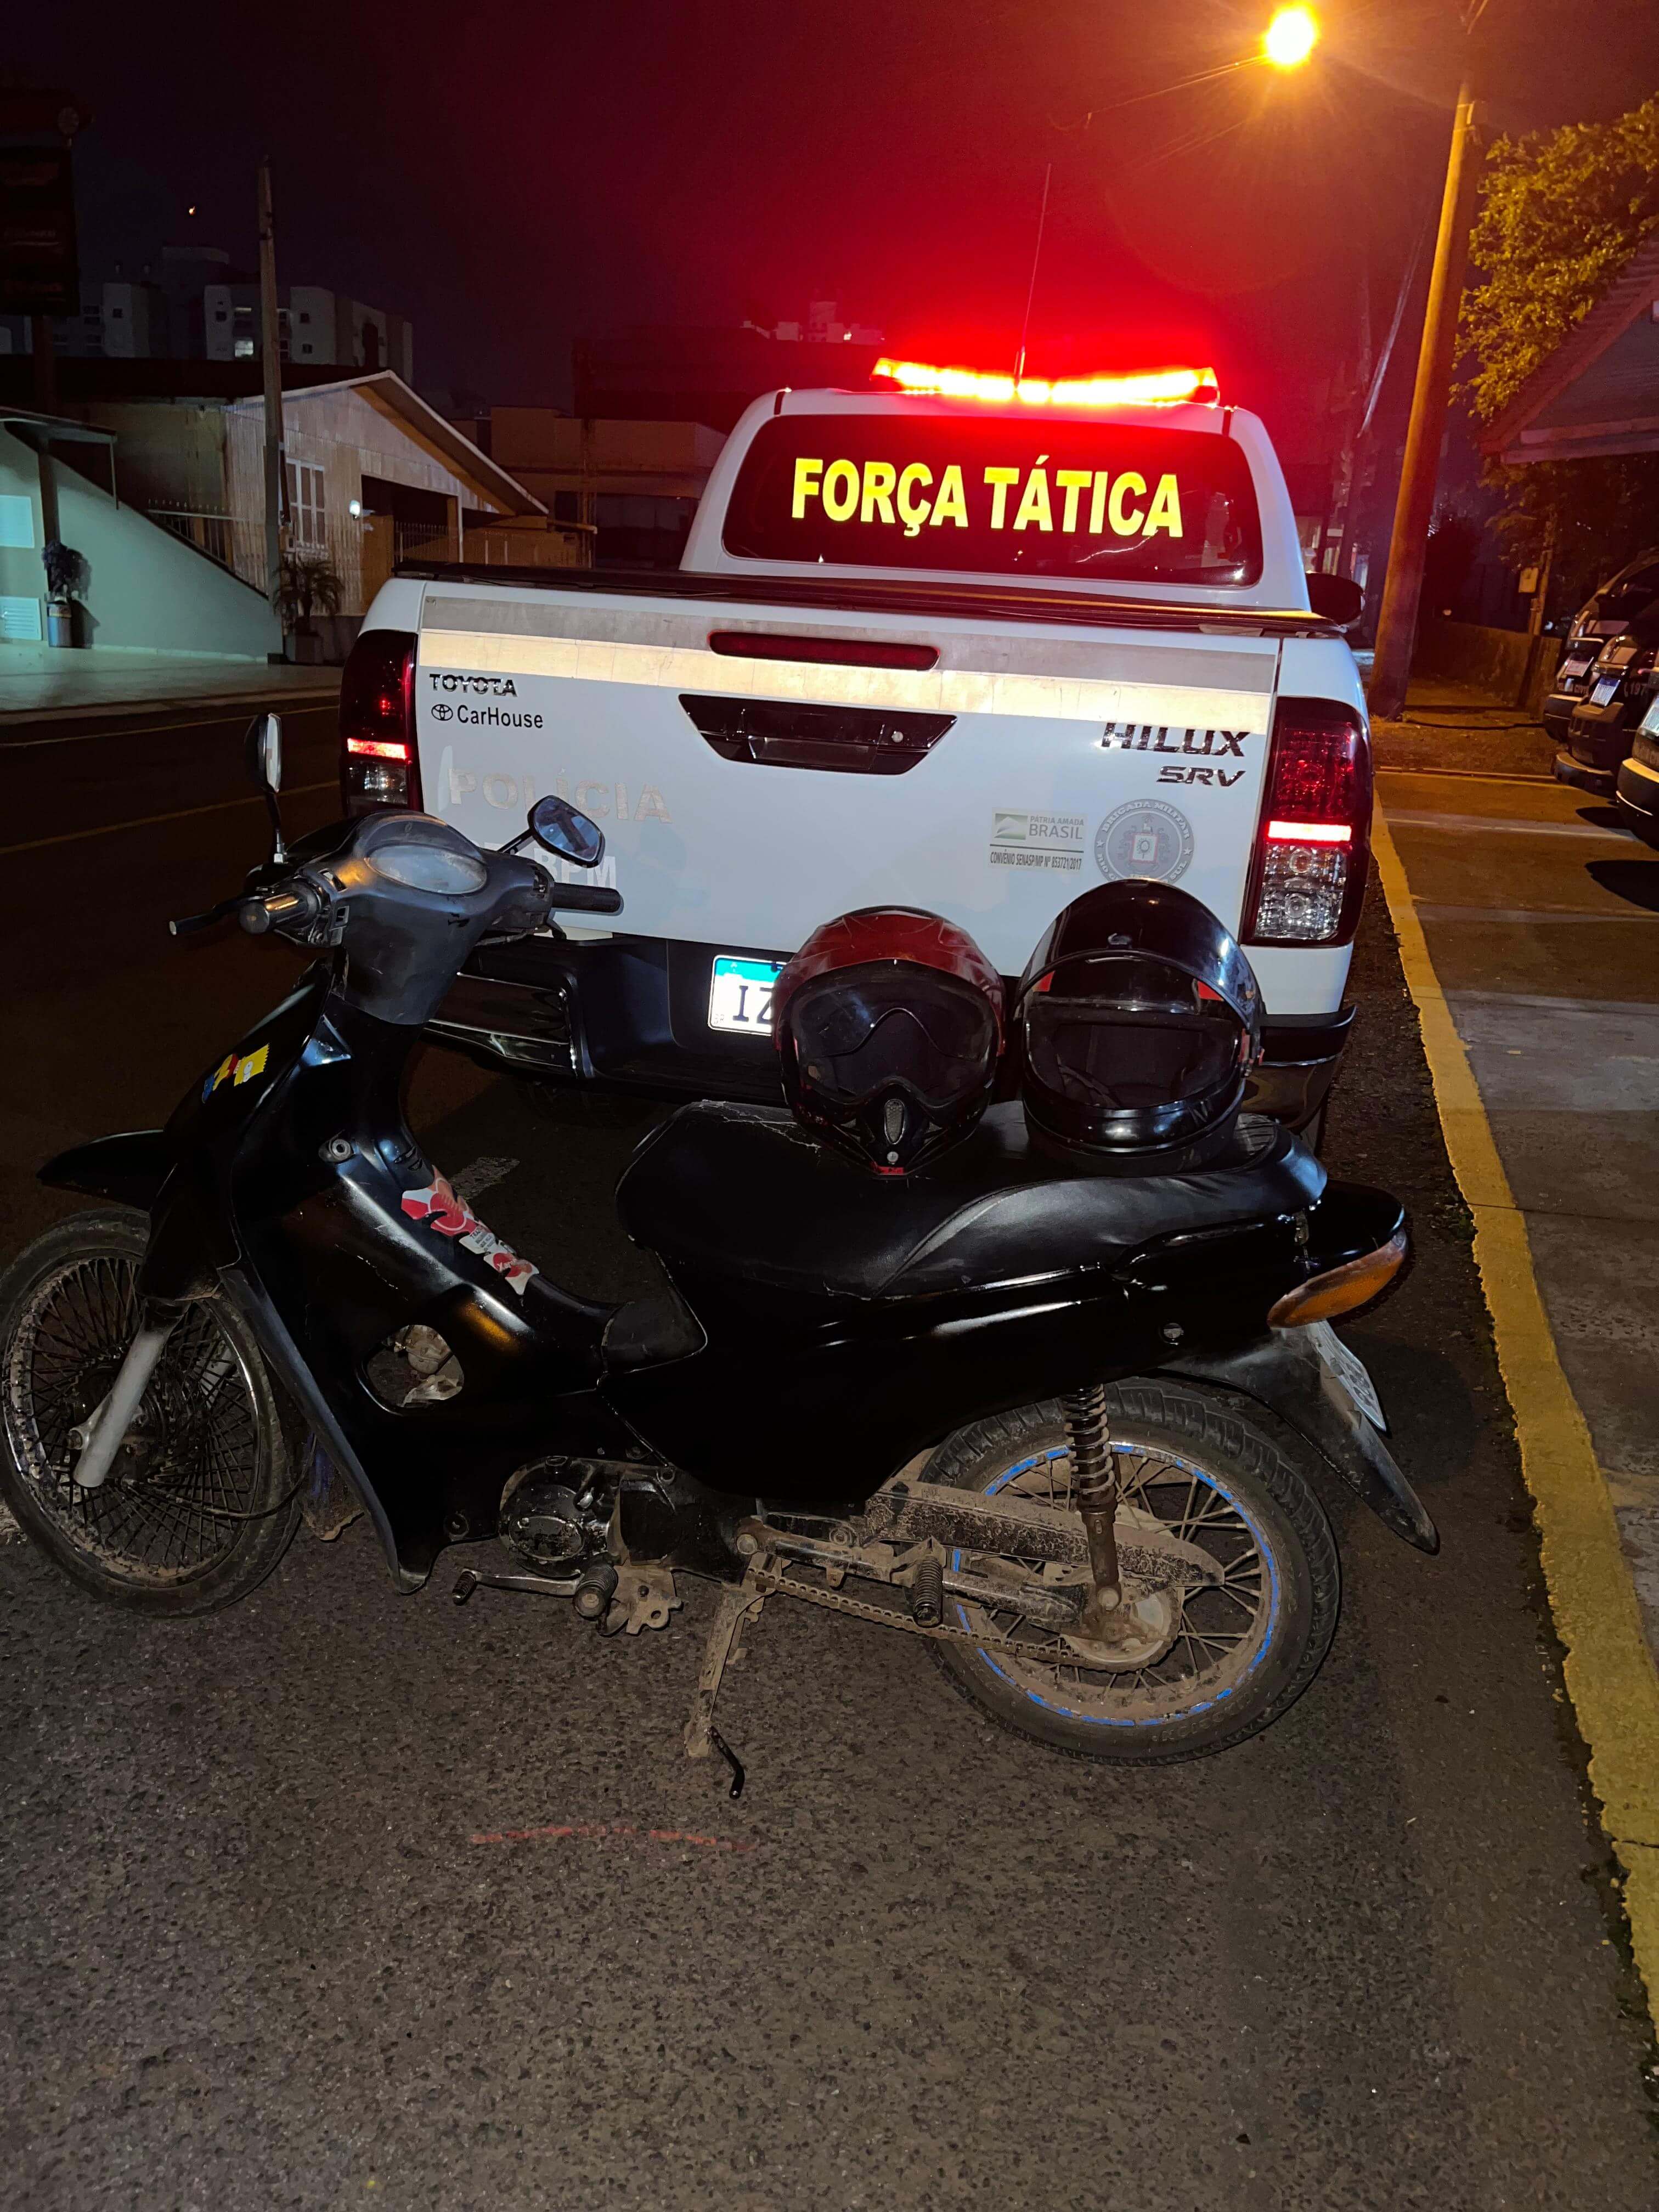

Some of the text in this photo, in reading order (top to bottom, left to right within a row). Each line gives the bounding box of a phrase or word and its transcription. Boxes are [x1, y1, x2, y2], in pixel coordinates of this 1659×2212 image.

[792, 455, 1183, 538] FORÇA TÁTICA
[429, 673, 517, 697] TOYOTA
[457, 704, 544, 729] CarHouse
[1100, 723, 1251, 757] HILUX
[1156, 766, 1246, 787] SRV
[448, 768, 673, 823] POLÍCIA
[1029, 823, 1083, 840] BRASIL
[1030, 815, 1085, 826] PÁTRIA AMADA
[1101, 801, 1190, 839] BRIGADA MILITAR
[990, 849, 1015, 865] CONVÊNIO
